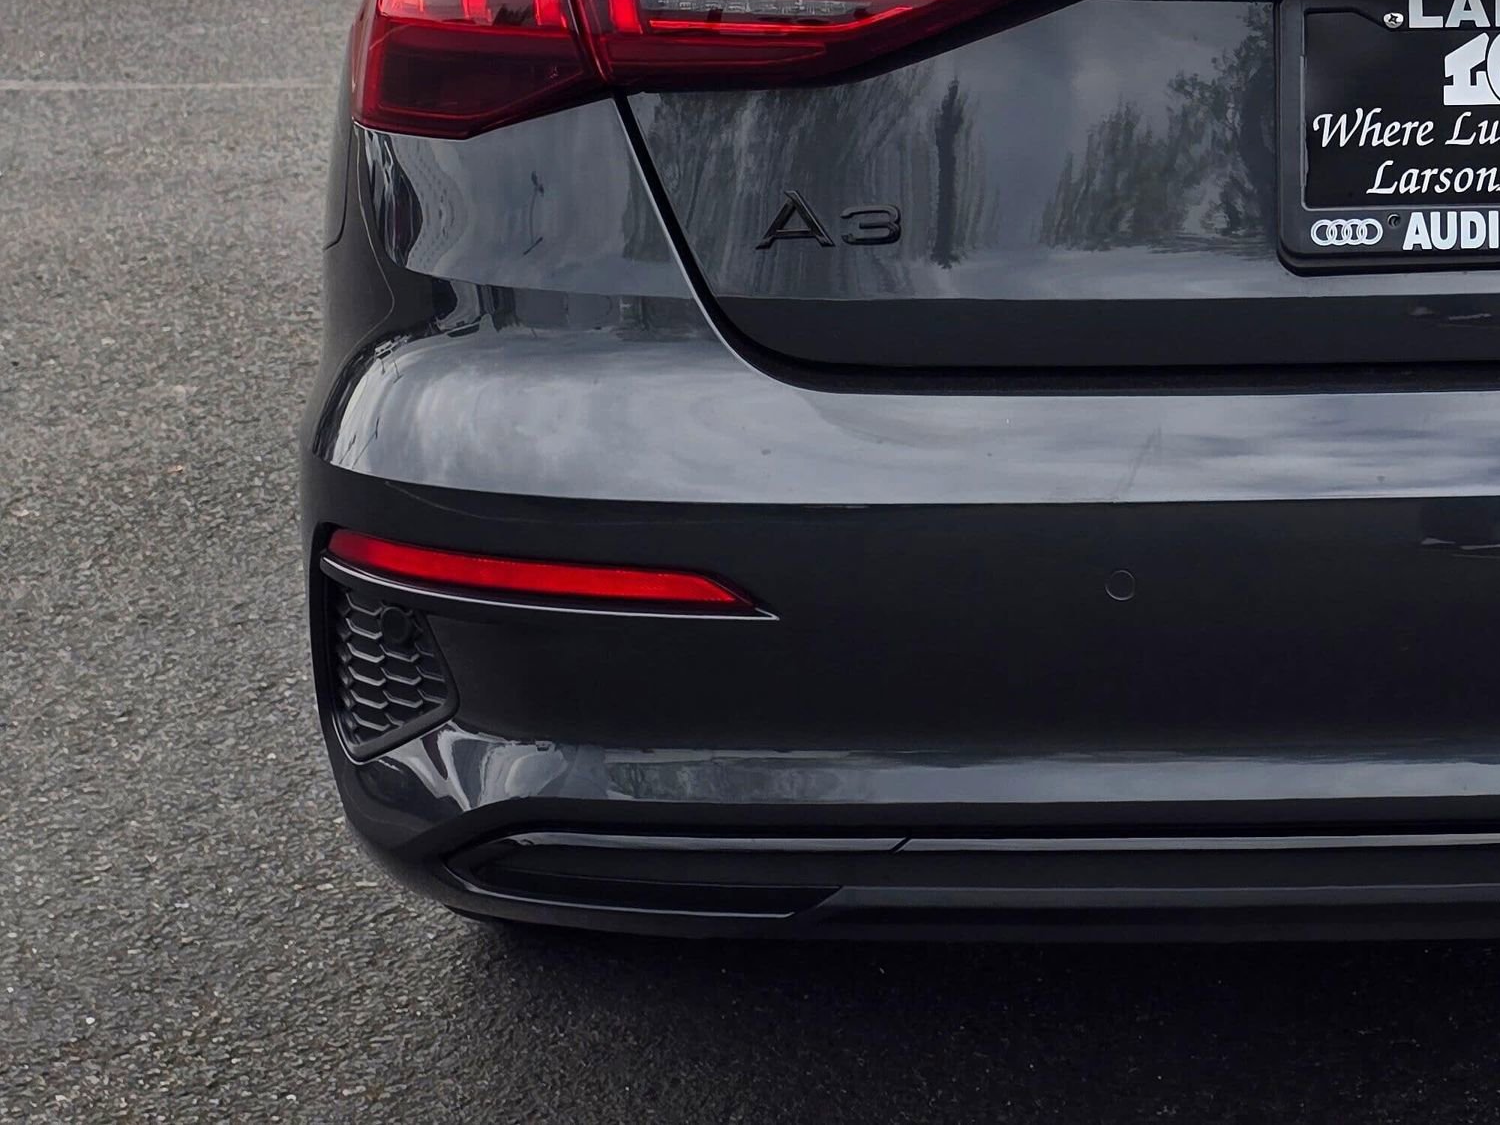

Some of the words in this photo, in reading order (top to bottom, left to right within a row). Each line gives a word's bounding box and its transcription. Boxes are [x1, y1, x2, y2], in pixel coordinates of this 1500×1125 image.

[1313, 107, 1434, 148] Where
[755, 190, 901, 250] A3
[1403, 210, 1500, 250] AUDI
